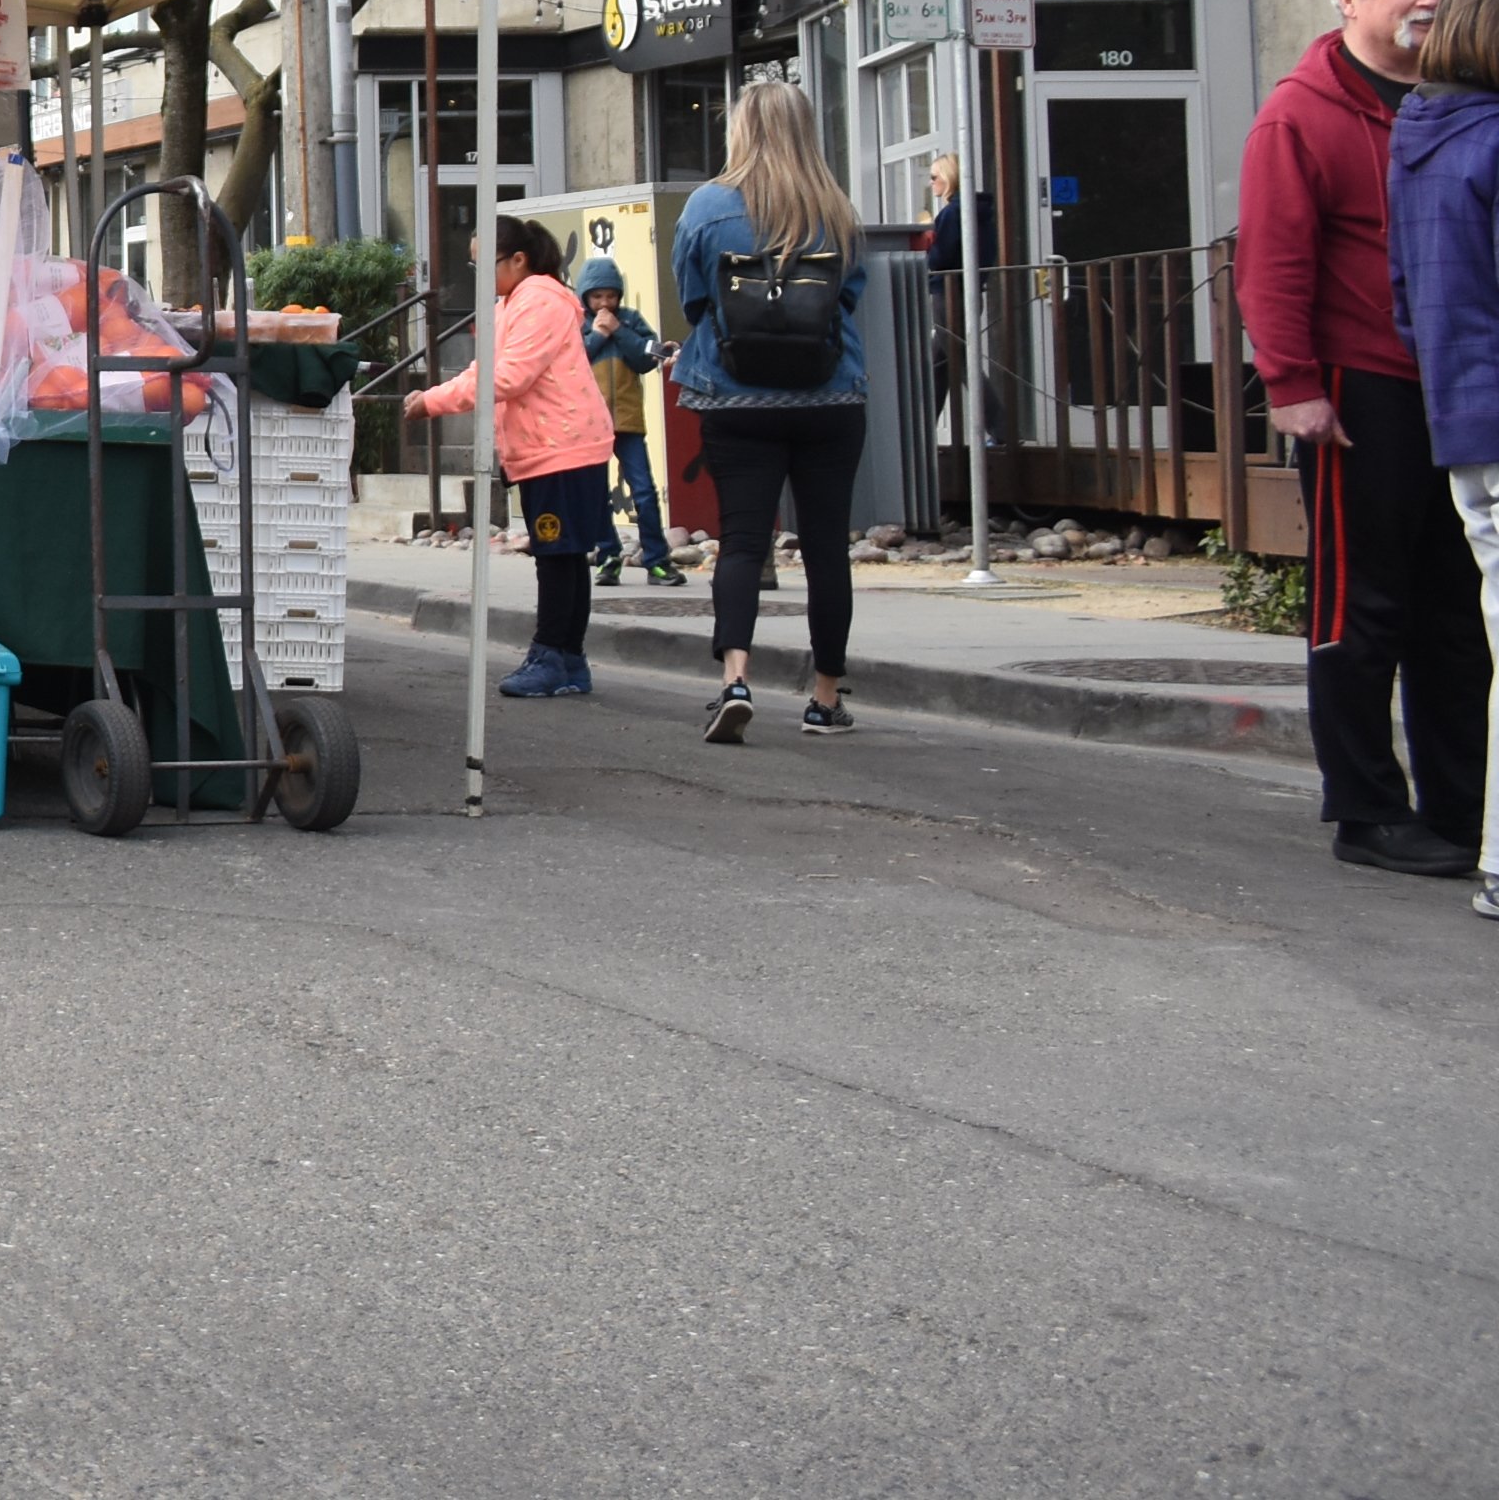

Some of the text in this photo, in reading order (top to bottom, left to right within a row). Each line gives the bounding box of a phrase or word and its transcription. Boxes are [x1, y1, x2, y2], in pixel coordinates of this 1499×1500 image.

[975, 8, 996, 23] 5AM
[1006, 9, 1027, 24] 3PM
[1099, 50, 1133, 66] 180
